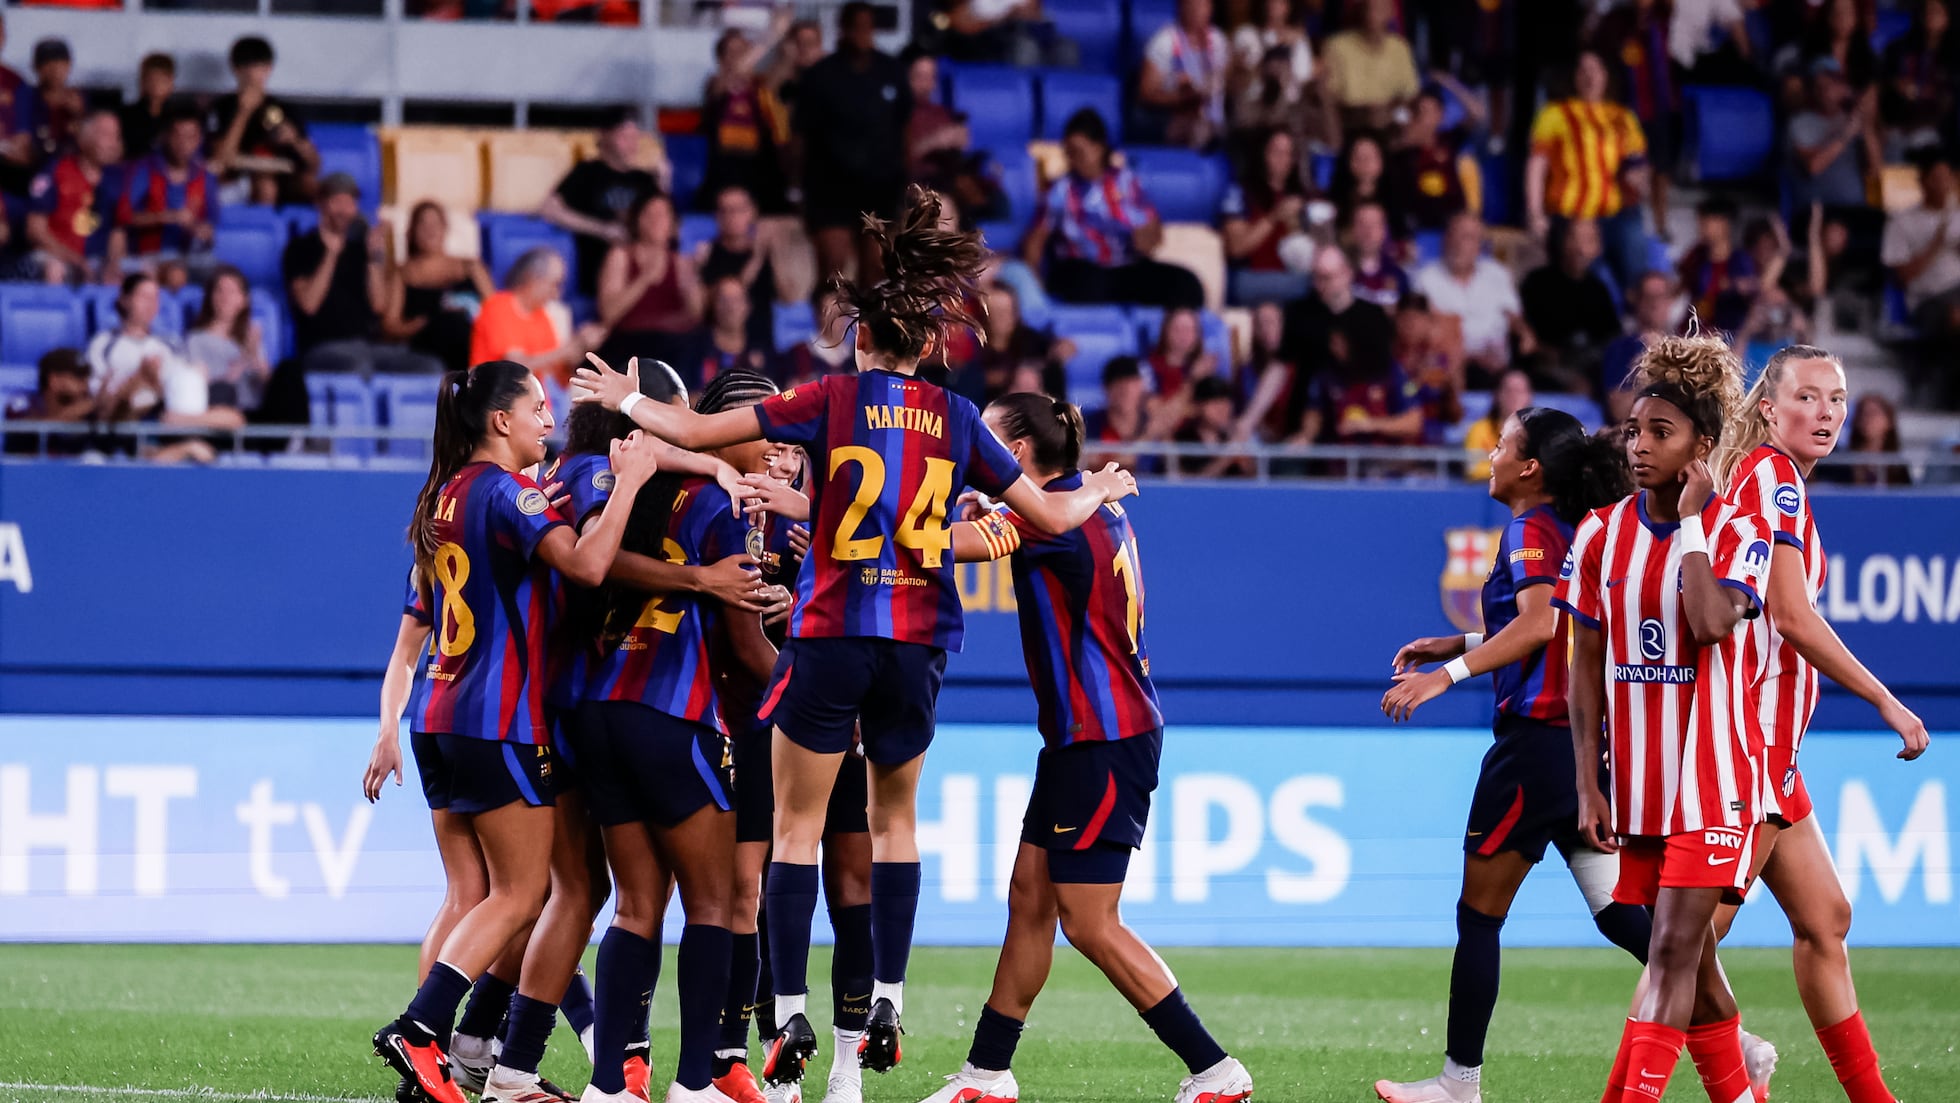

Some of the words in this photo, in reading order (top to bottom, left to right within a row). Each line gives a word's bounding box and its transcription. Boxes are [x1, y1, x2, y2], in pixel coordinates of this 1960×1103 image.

[865, 405, 942, 440] MARTINA
[829, 445, 956, 568] 24
[1511, 549, 1543, 563] BIMBO
[1817, 553, 1960, 624] LON
[1615, 666, 1664, 681] RIYADH
[1668, 668, 1695, 682] AIR
[0, 763, 200, 897] HT
[236, 777, 374, 900] tv
[1704, 832, 1743, 849] DKV
